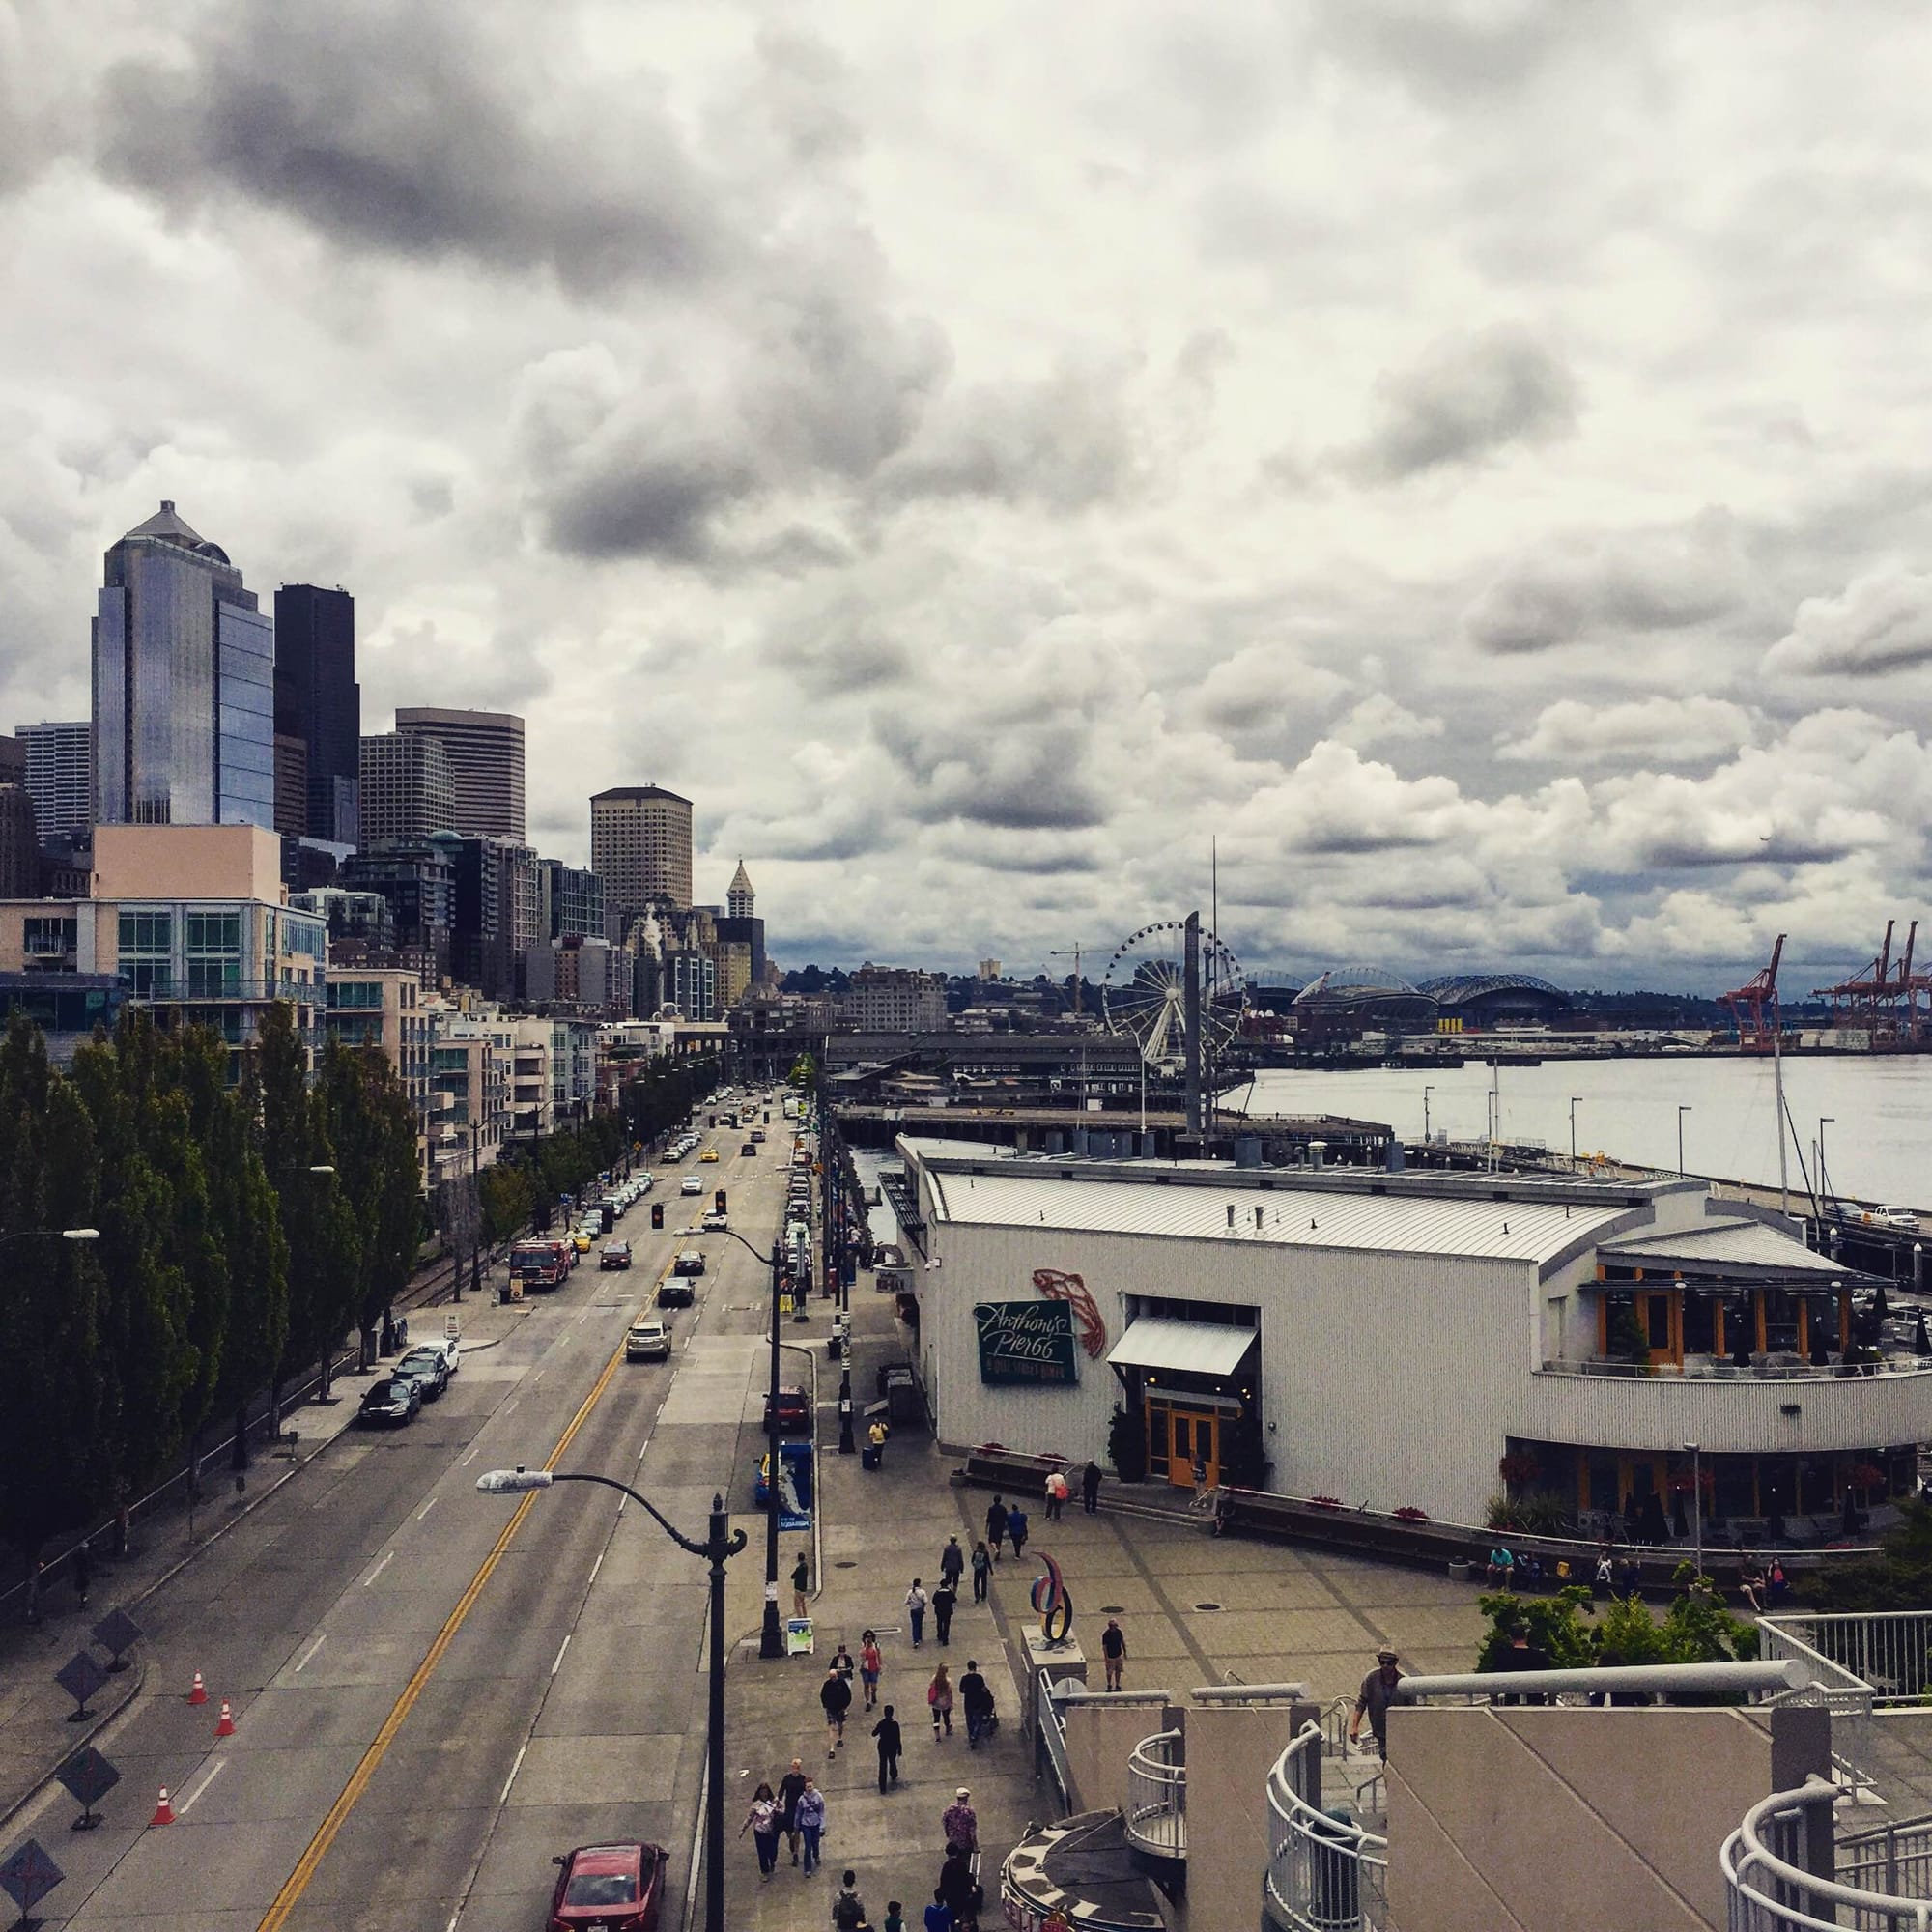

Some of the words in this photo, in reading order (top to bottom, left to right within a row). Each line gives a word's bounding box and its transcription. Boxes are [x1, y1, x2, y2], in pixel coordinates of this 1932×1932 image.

[974, 1304, 1074, 1340] Anthony's
[983, 1330, 1031, 1356] Pier
[1031, 1337, 1059, 1359] 66
